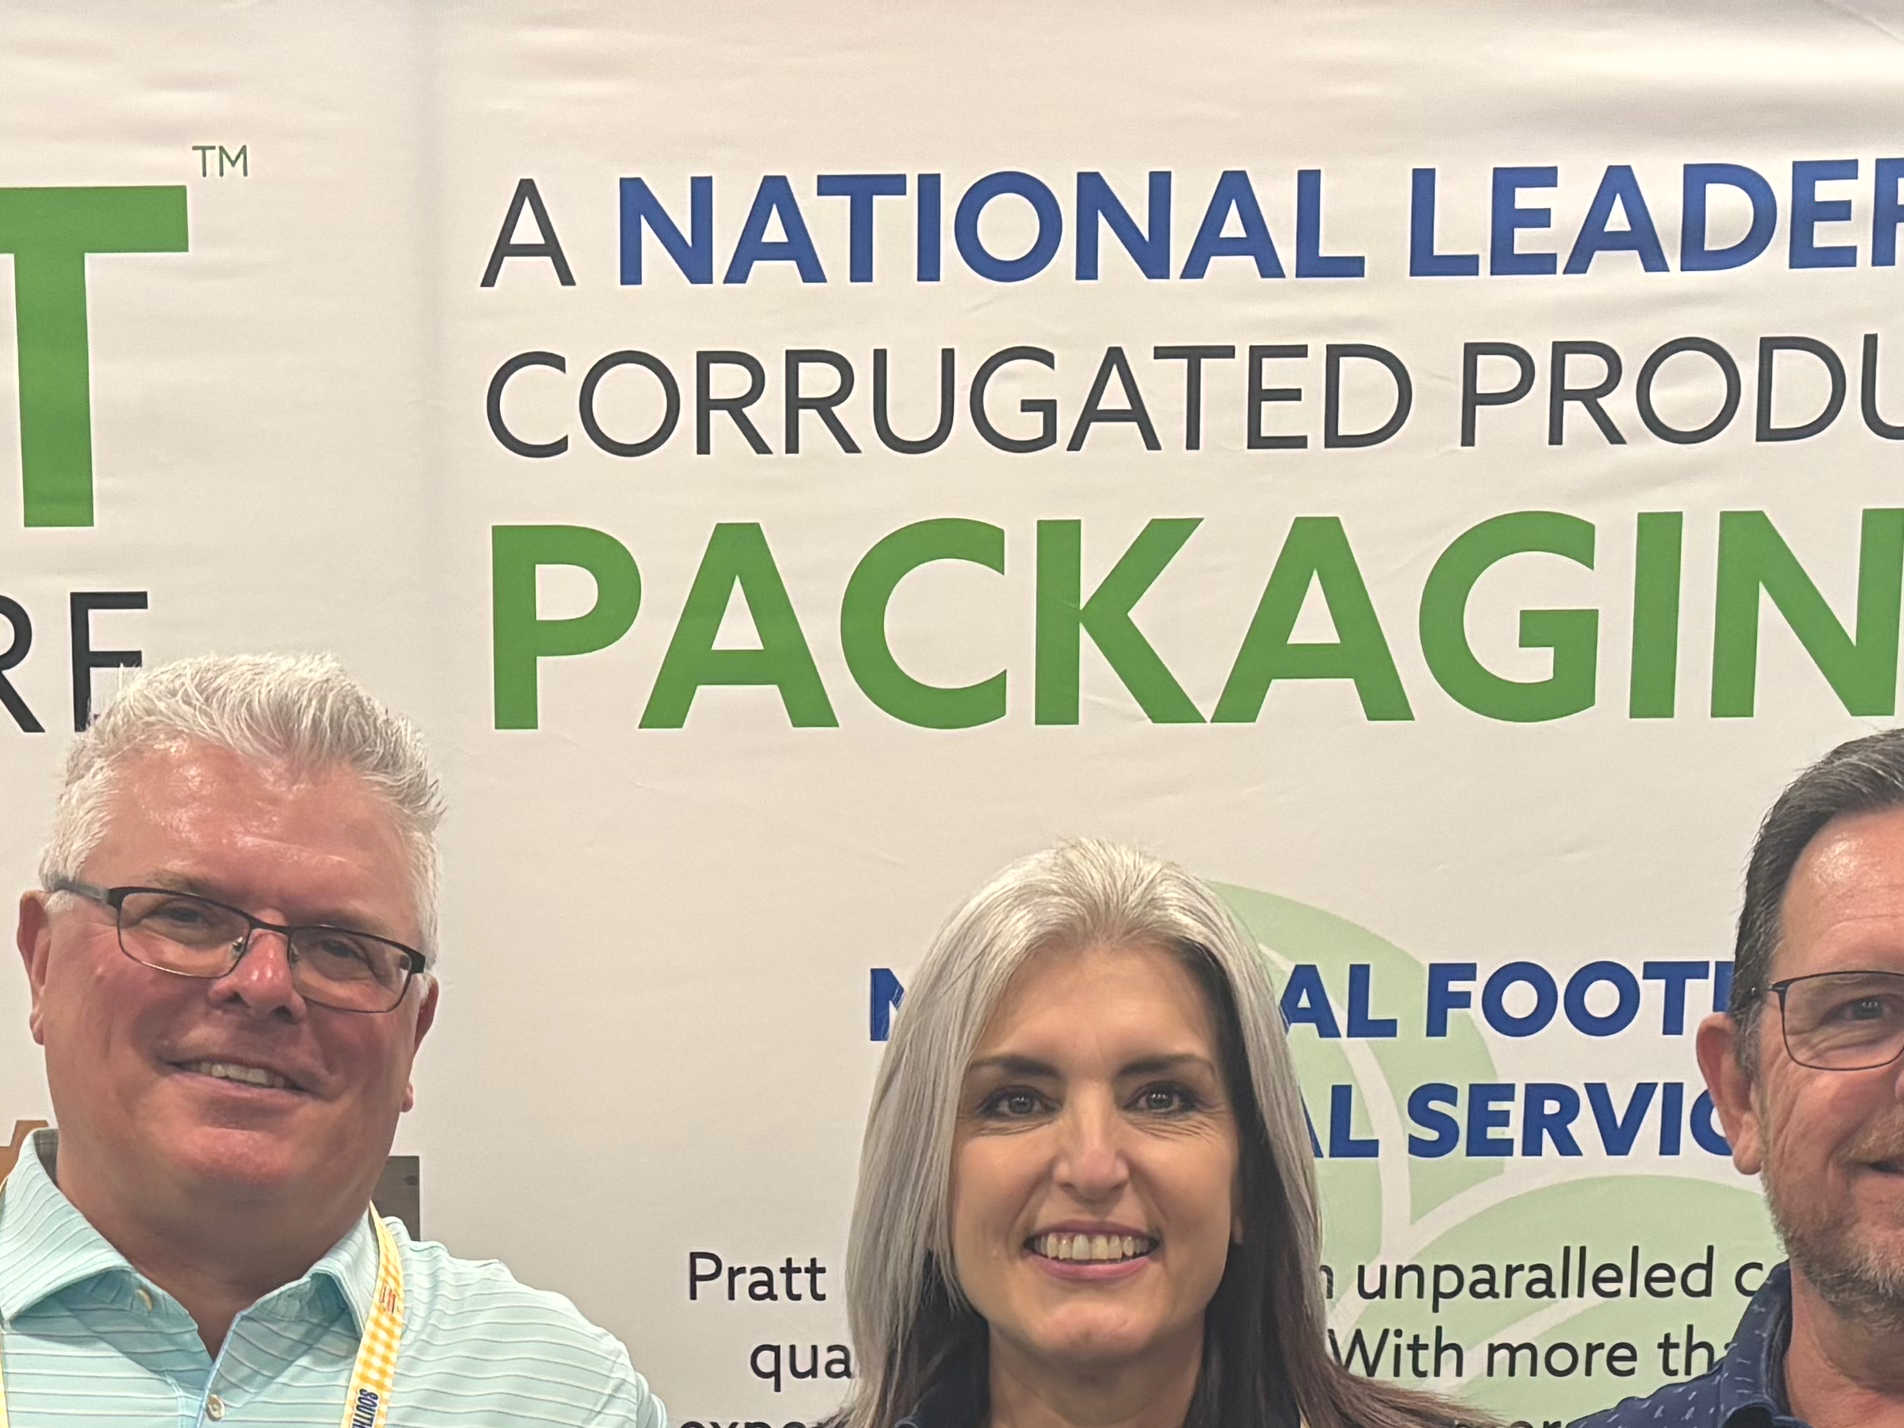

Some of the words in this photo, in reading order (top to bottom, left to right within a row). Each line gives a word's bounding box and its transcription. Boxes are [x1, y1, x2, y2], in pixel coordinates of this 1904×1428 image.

[193, 144, 250, 178] TM
[480, 178, 576, 290] A
[618, 168, 1365, 286] NATIONAL
[486, 343, 1413, 459] CORRUGATED
[1426, 960, 1736, 1038] FOOT
[688, 1251, 827, 1302] Pratt
[1357, 1245, 1714, 1313] unparalleled
[1327, 1325, 1465, 1378] With
[1486, 1341, 1638, 1377] more
